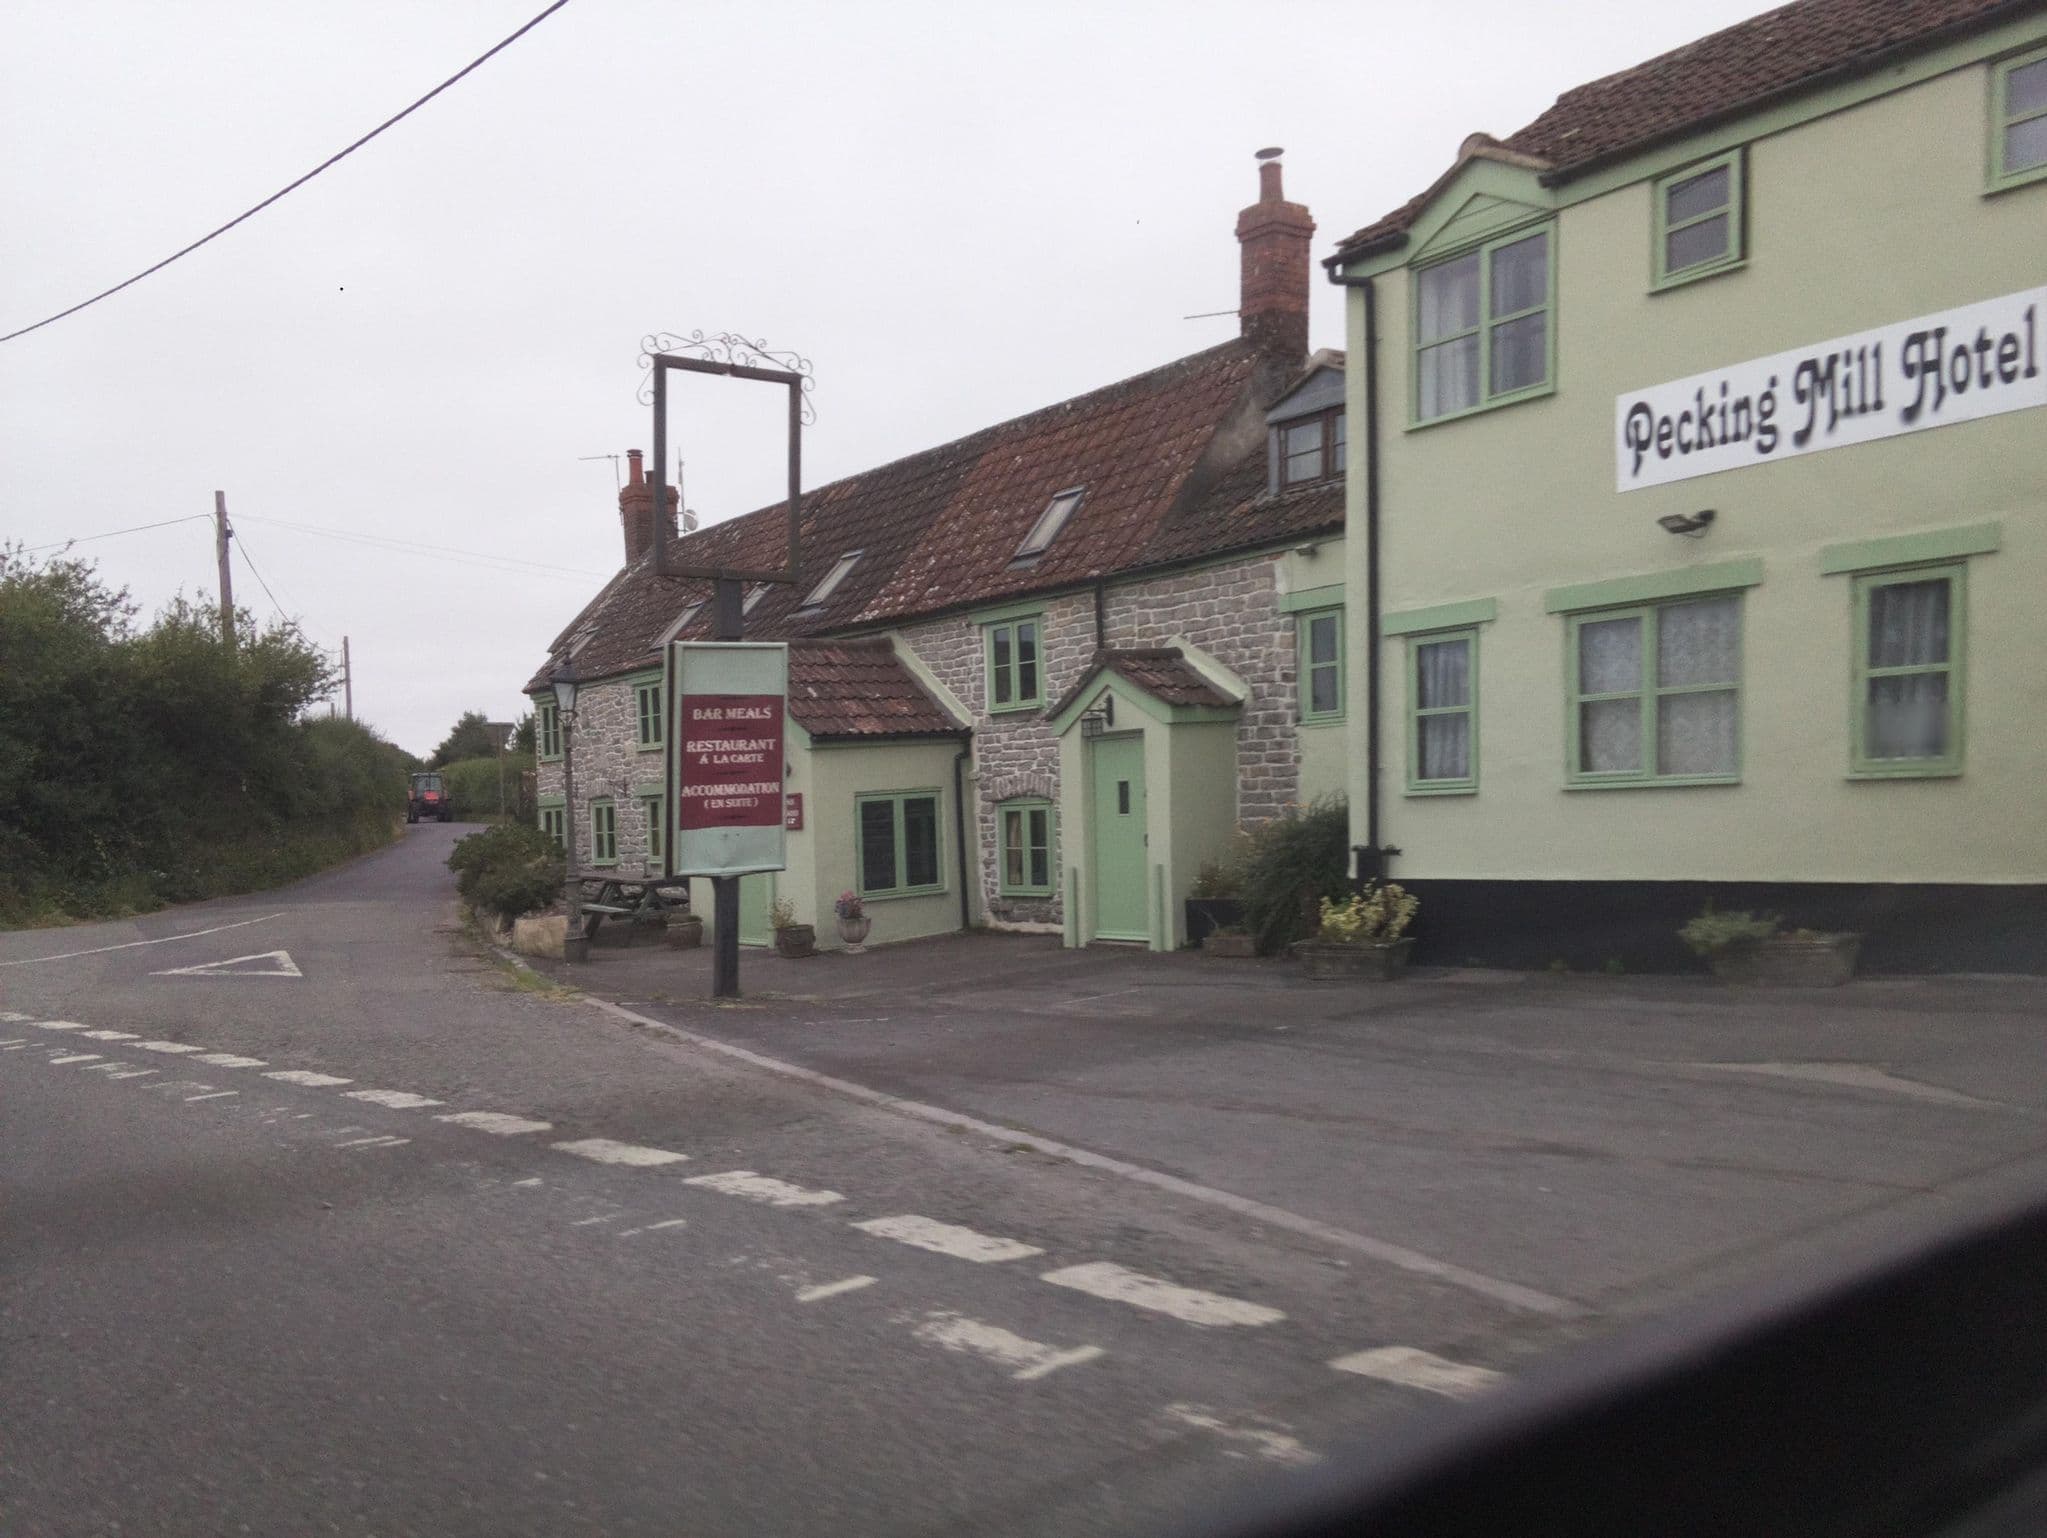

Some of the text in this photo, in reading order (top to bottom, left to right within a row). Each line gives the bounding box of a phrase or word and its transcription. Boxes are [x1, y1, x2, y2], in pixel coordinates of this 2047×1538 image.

[1625, 303, 2038, 477] Pecking Mill Hotel
[693, 706, 772, 720] BAR MEALS
[686, 739, 776, 752] RESTAURANT
[712, 754, 729, 764] LA
[730, 753, 765, 763] CARTE
[681, 782, 780, 797] ACCOMMODATION
